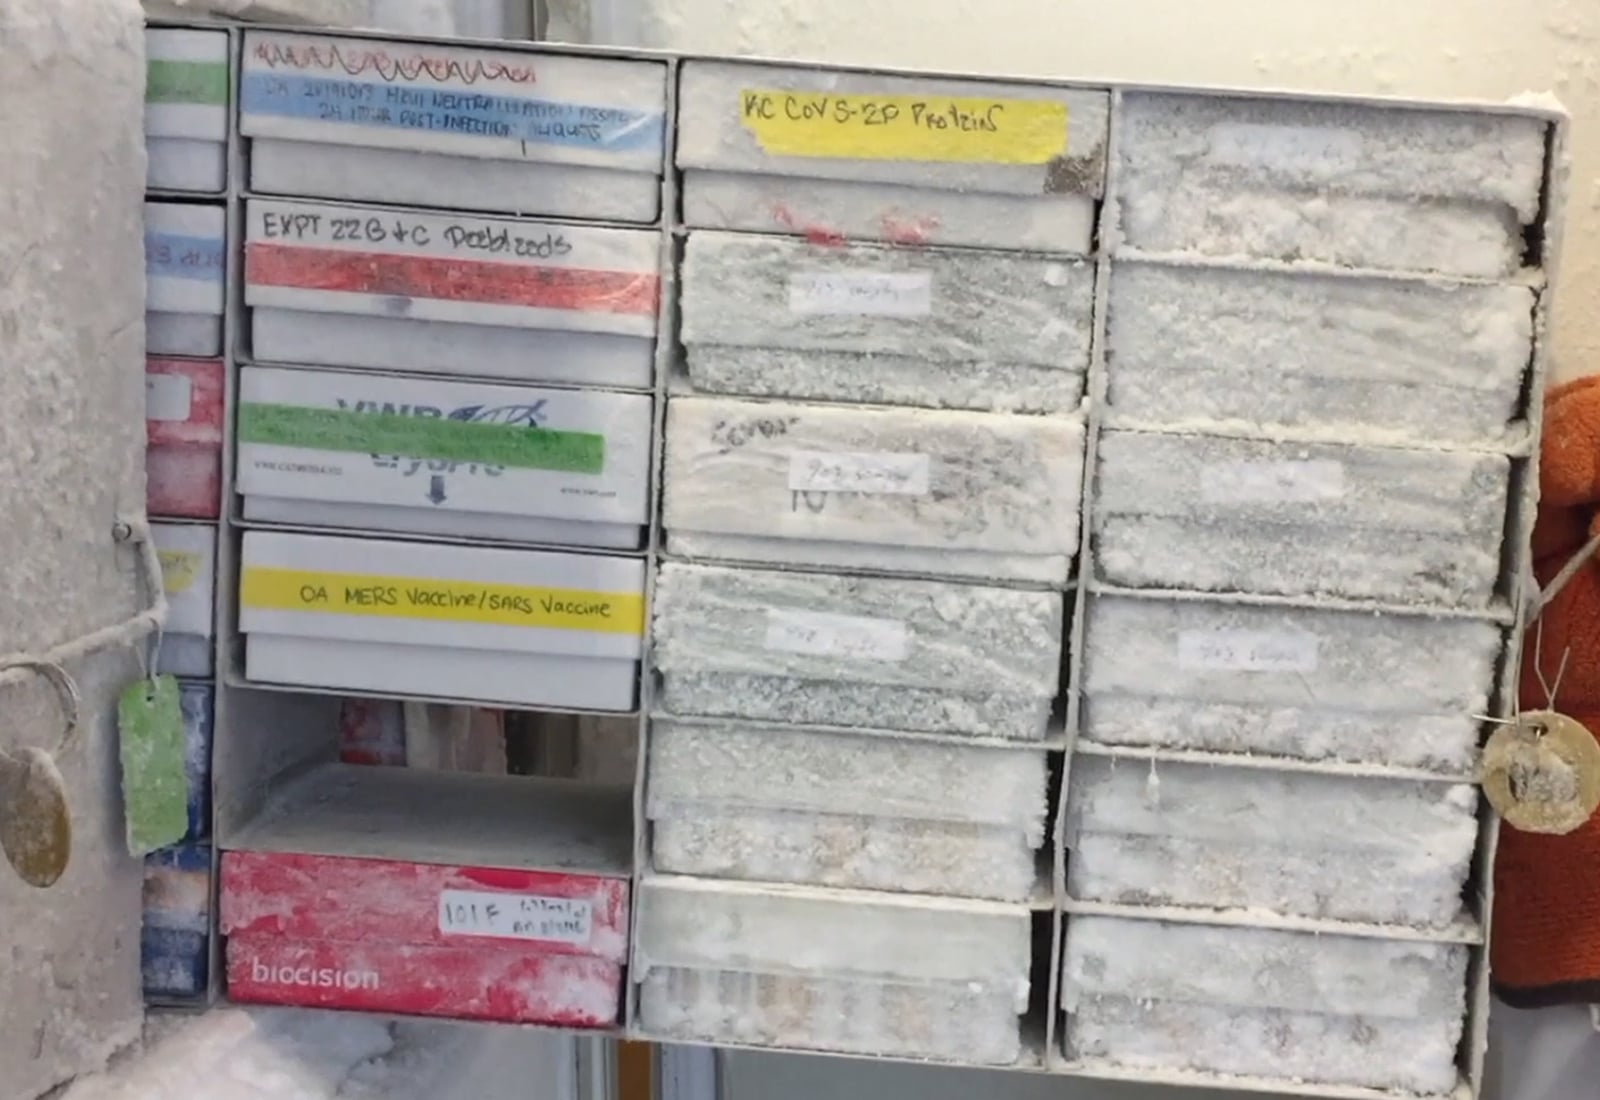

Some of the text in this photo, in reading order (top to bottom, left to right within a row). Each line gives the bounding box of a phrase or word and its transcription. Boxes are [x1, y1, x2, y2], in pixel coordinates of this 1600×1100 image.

[300, 585, 328, 604] OA
[345, 586, 397, 607] MERS
[540, 592, 611, 617] Vaccine
[252, 955, 379, 991] biocision
